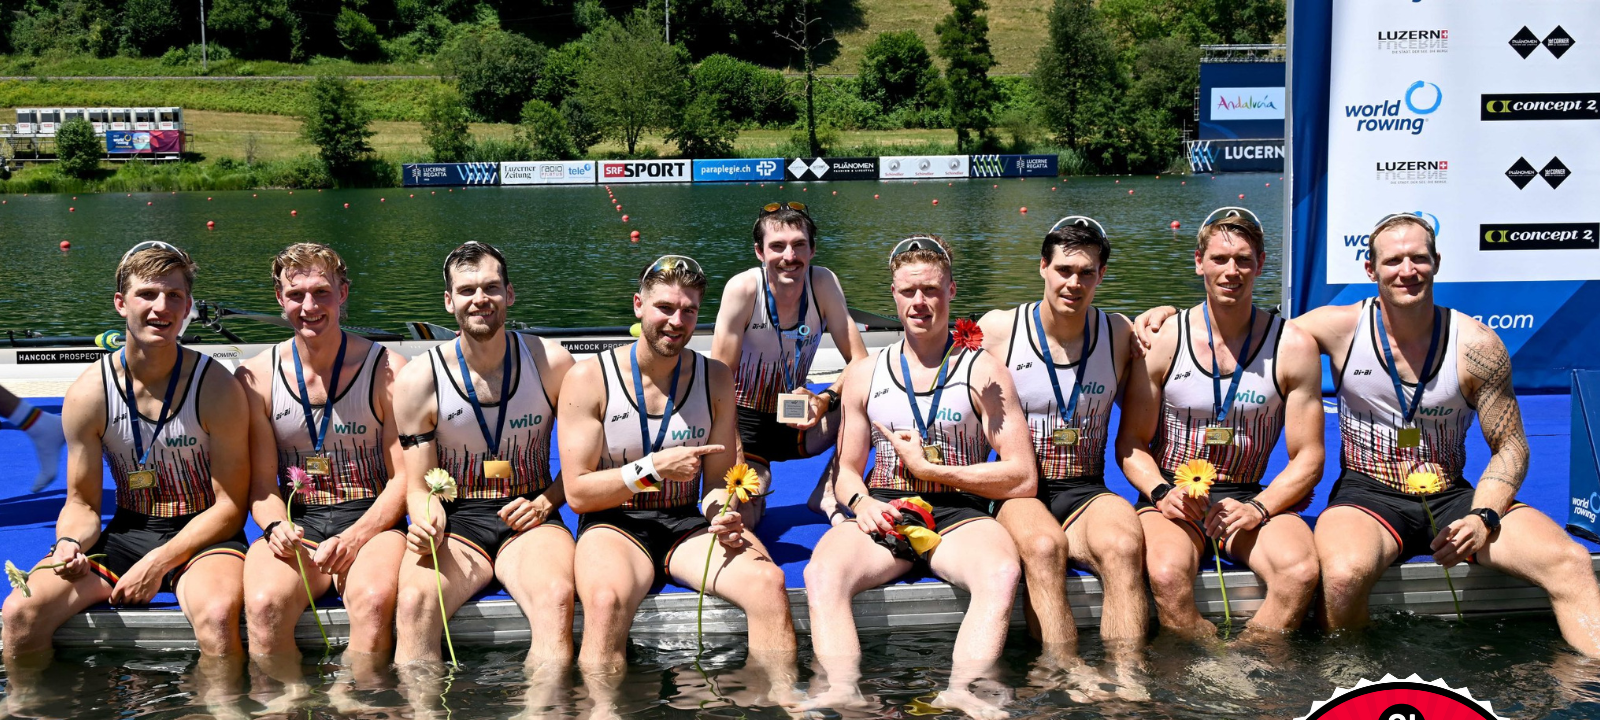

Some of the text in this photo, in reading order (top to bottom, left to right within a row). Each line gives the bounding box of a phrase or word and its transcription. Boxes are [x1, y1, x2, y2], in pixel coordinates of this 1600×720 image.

[1378, 30, 1440, 40] LUZERN
[1217, 95, 1277, 110] Andalucía
[1345, 100, 1401, 117] world
[1513, 100, 1597, 112] concept 2
[1357, 118, 1424, 135] rowing
[1225, 146, 1285, 159] LUCERN
[606, 162, 685, 177] SRF SPORT
[701, 164, 751, 174] paraplegie.ch
[1376, 161, 1438, 171] LUZERN
[1510, 229, 1593, 242] concept 2
[562, 343, 600, 351] HANCOCK
[19, 352, 111, 361] HANCOCK PROSPECTI
[1234, 390, 1267, 405] wilo
[1420, 406, 1453, 416] wilo
[509, 414, 542, 429] wilo
[334, 422, 367, 435] wilo
[671, 426, 705, 441] wilo
[165, 435, 197, 448] wilo
[1572, 497, 1590, 509] world
[1574, 506, 1596, 523] rowing
